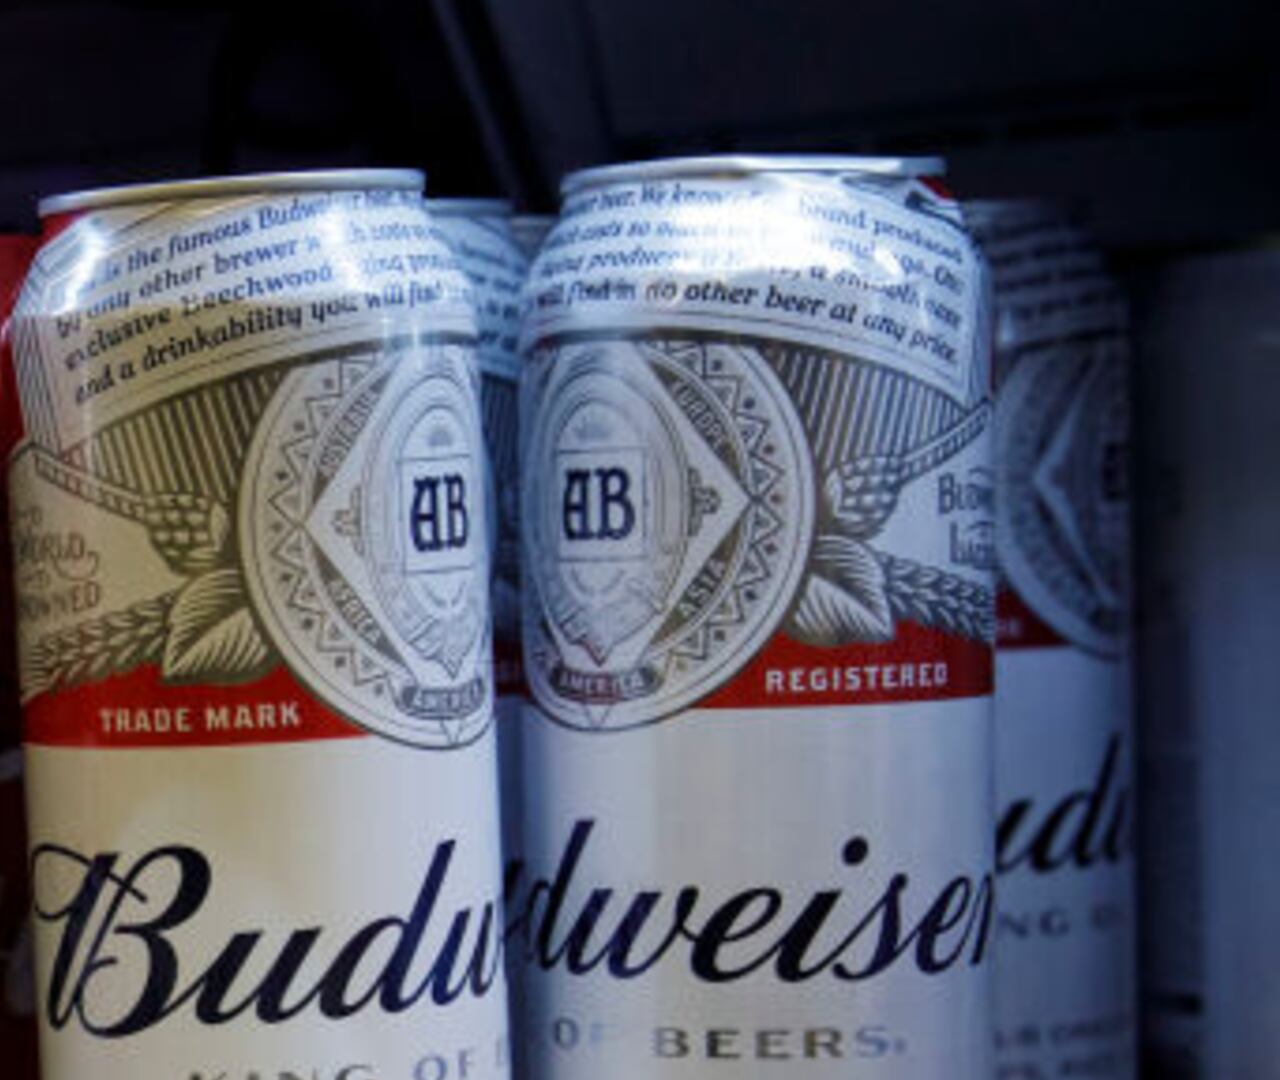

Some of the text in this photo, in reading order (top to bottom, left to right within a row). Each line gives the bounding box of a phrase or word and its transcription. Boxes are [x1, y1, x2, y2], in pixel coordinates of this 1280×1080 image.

[126, 242, 164, 276] the
[166, 217, 255, 262] famous
[137, 261, 204, 302] other
[683, 278, 759, 305] other
[764, 283, 827, 317] beer
[828, 301, 859, 324] at
[861, 312, 908, 345] any
[64, 305, 171, 370] exclusive
[141, 302, 304, 369] drinkability
[562, 467, 636, 541] AB
[763, 662, 950, 693] REGISTERED
[98, 701, 303, 733] TRADE MARK
